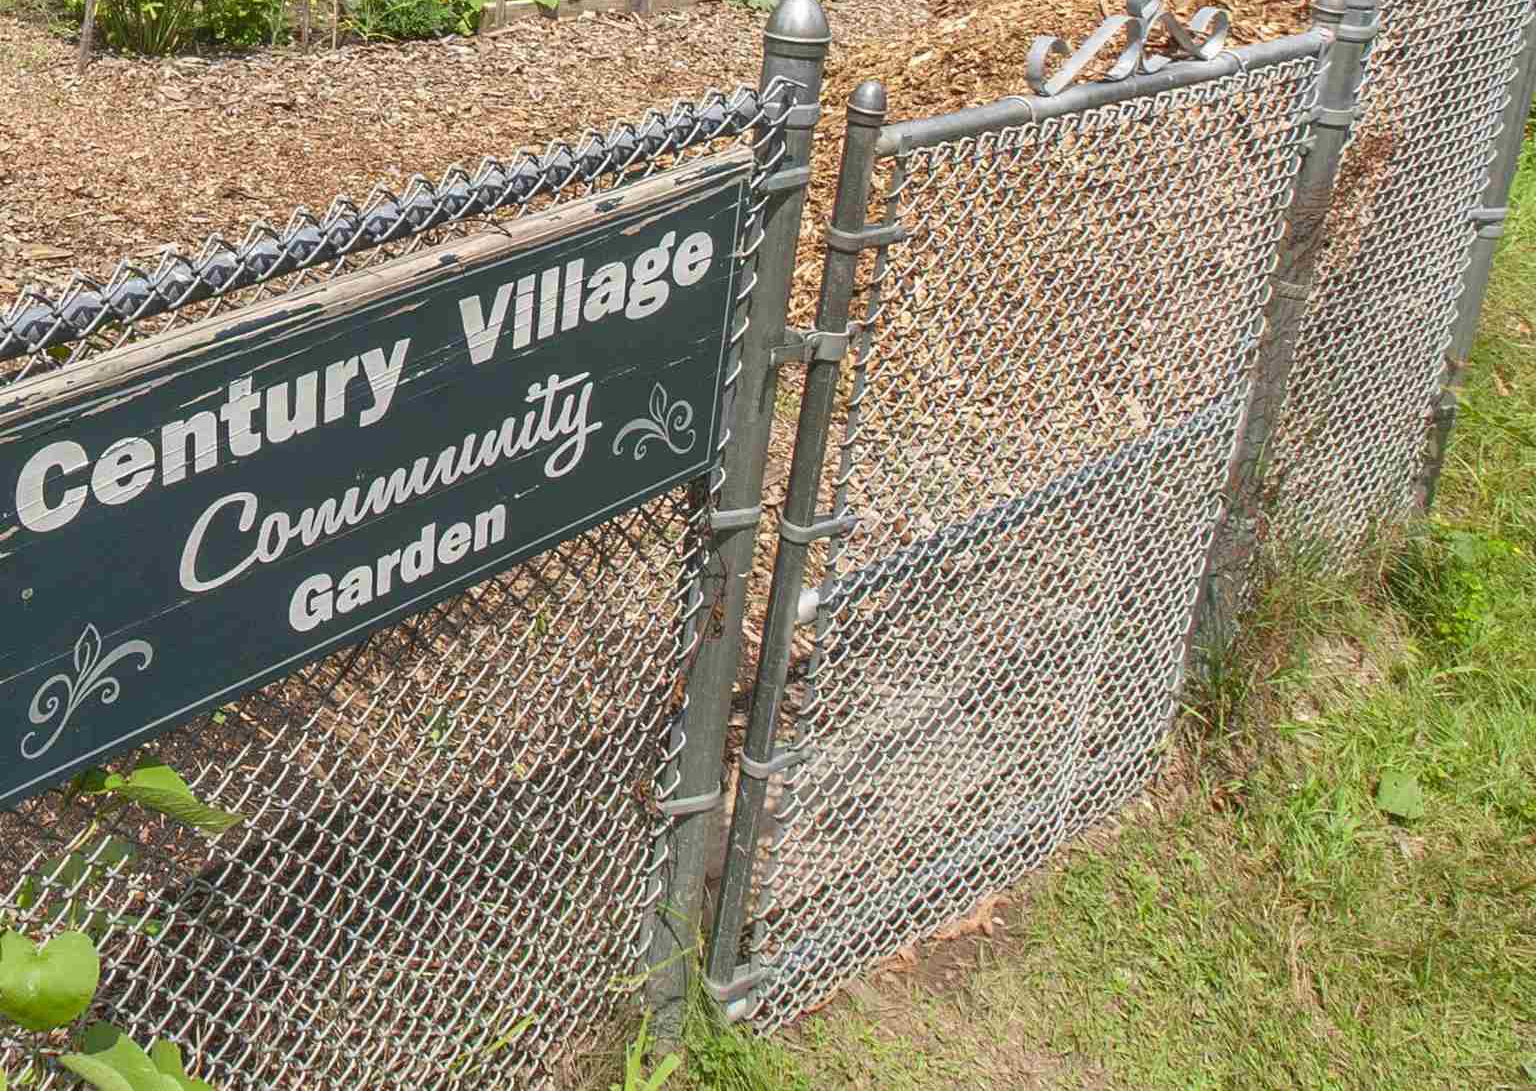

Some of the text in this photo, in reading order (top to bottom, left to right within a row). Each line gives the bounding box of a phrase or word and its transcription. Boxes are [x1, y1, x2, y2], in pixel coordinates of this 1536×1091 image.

[15, 230, 713, 532] Century Village
[178, 371, 602, 593] Community
[288, 503, 506, 632] Garden
